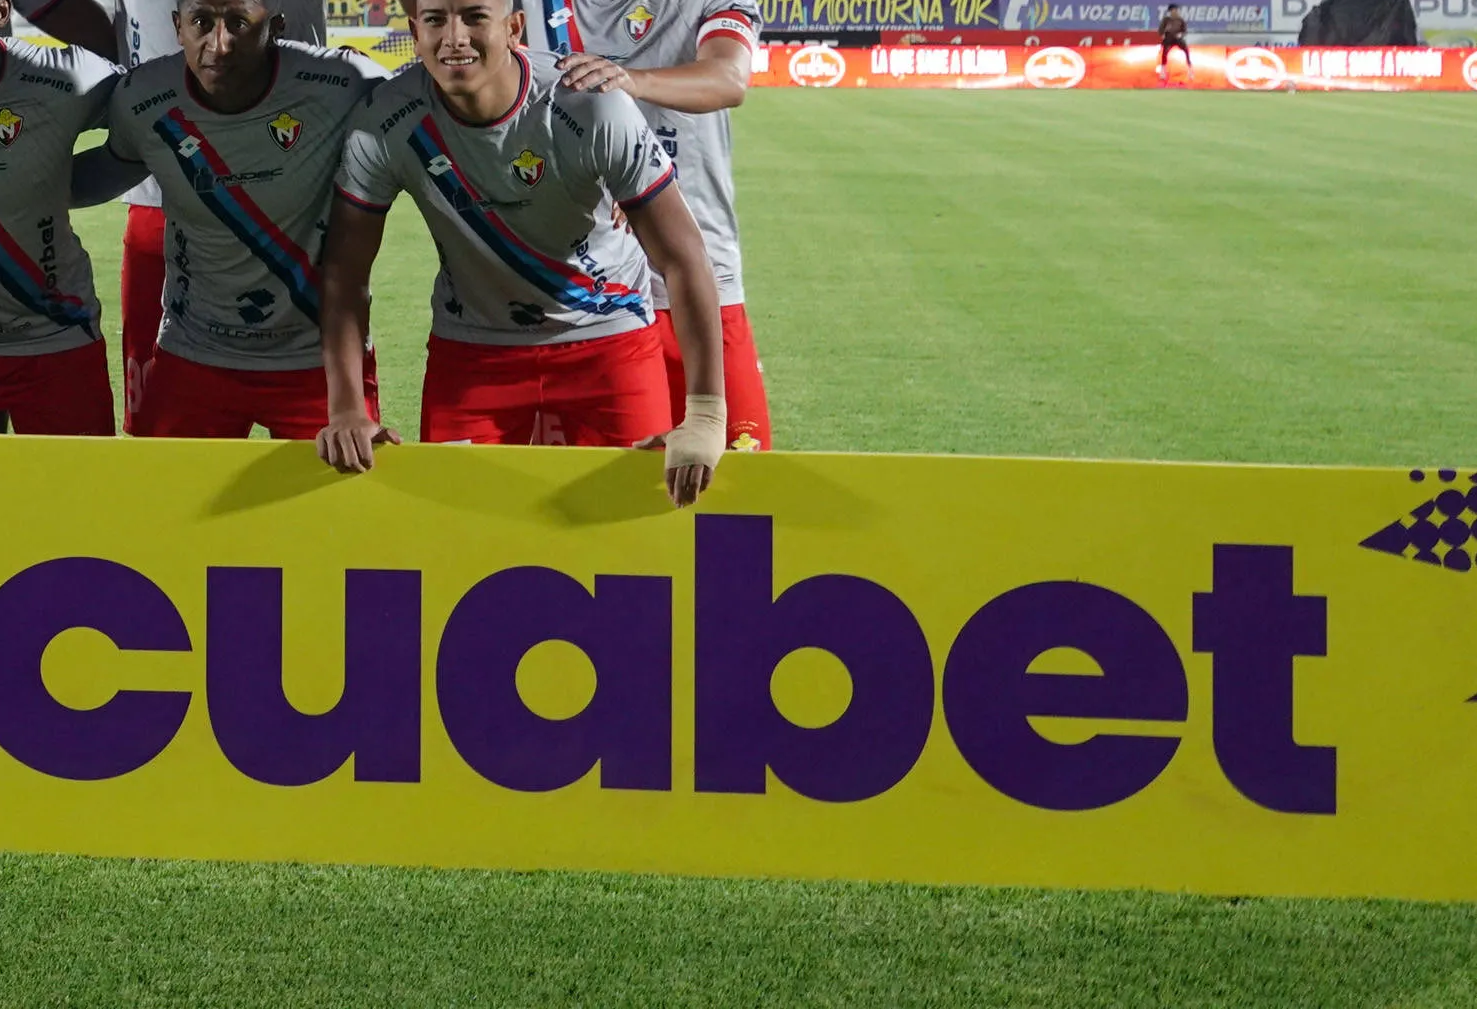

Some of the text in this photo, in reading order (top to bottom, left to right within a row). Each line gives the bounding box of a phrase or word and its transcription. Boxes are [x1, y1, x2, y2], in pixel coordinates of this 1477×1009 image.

[1052, 5, 1269, 22] LA VOZ DEL TMEBAMBA
